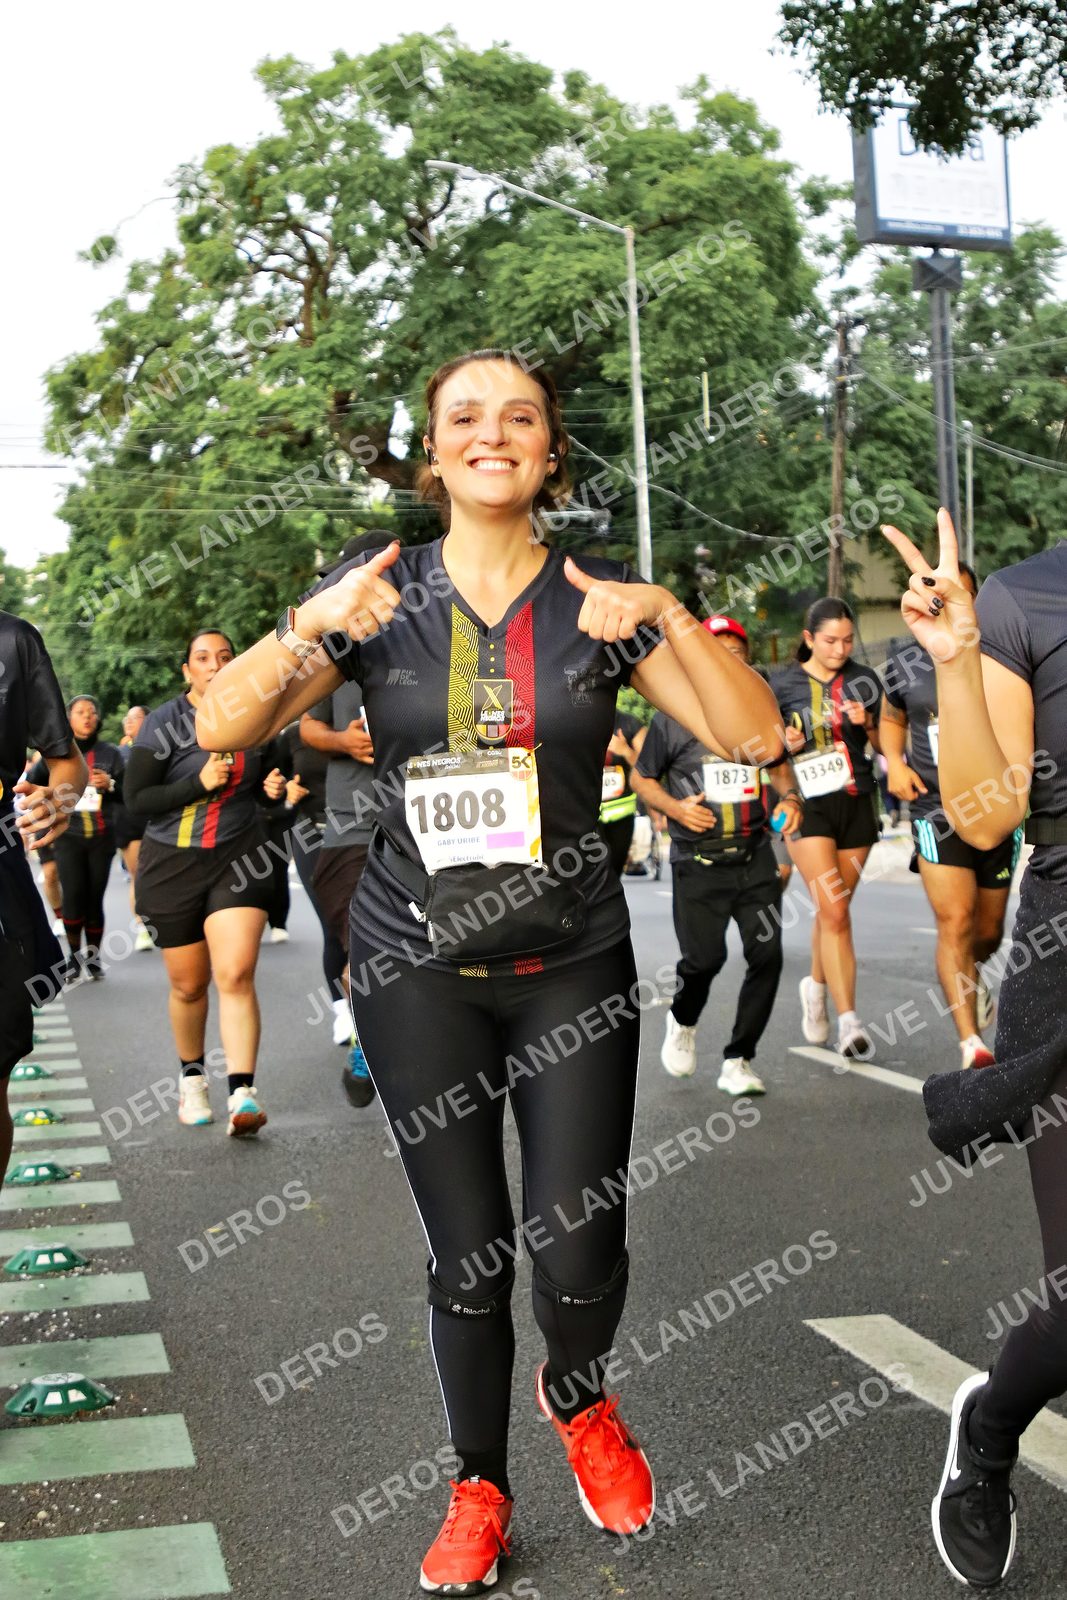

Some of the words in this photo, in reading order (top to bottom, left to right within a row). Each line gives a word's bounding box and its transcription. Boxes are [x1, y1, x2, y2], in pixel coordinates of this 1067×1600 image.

[511, 756, 531, 769] 5K
[800, 757, 844, 781] 13349
[714, 768, 749, 785] 1873
[410, 788, 507, 834] 1808
